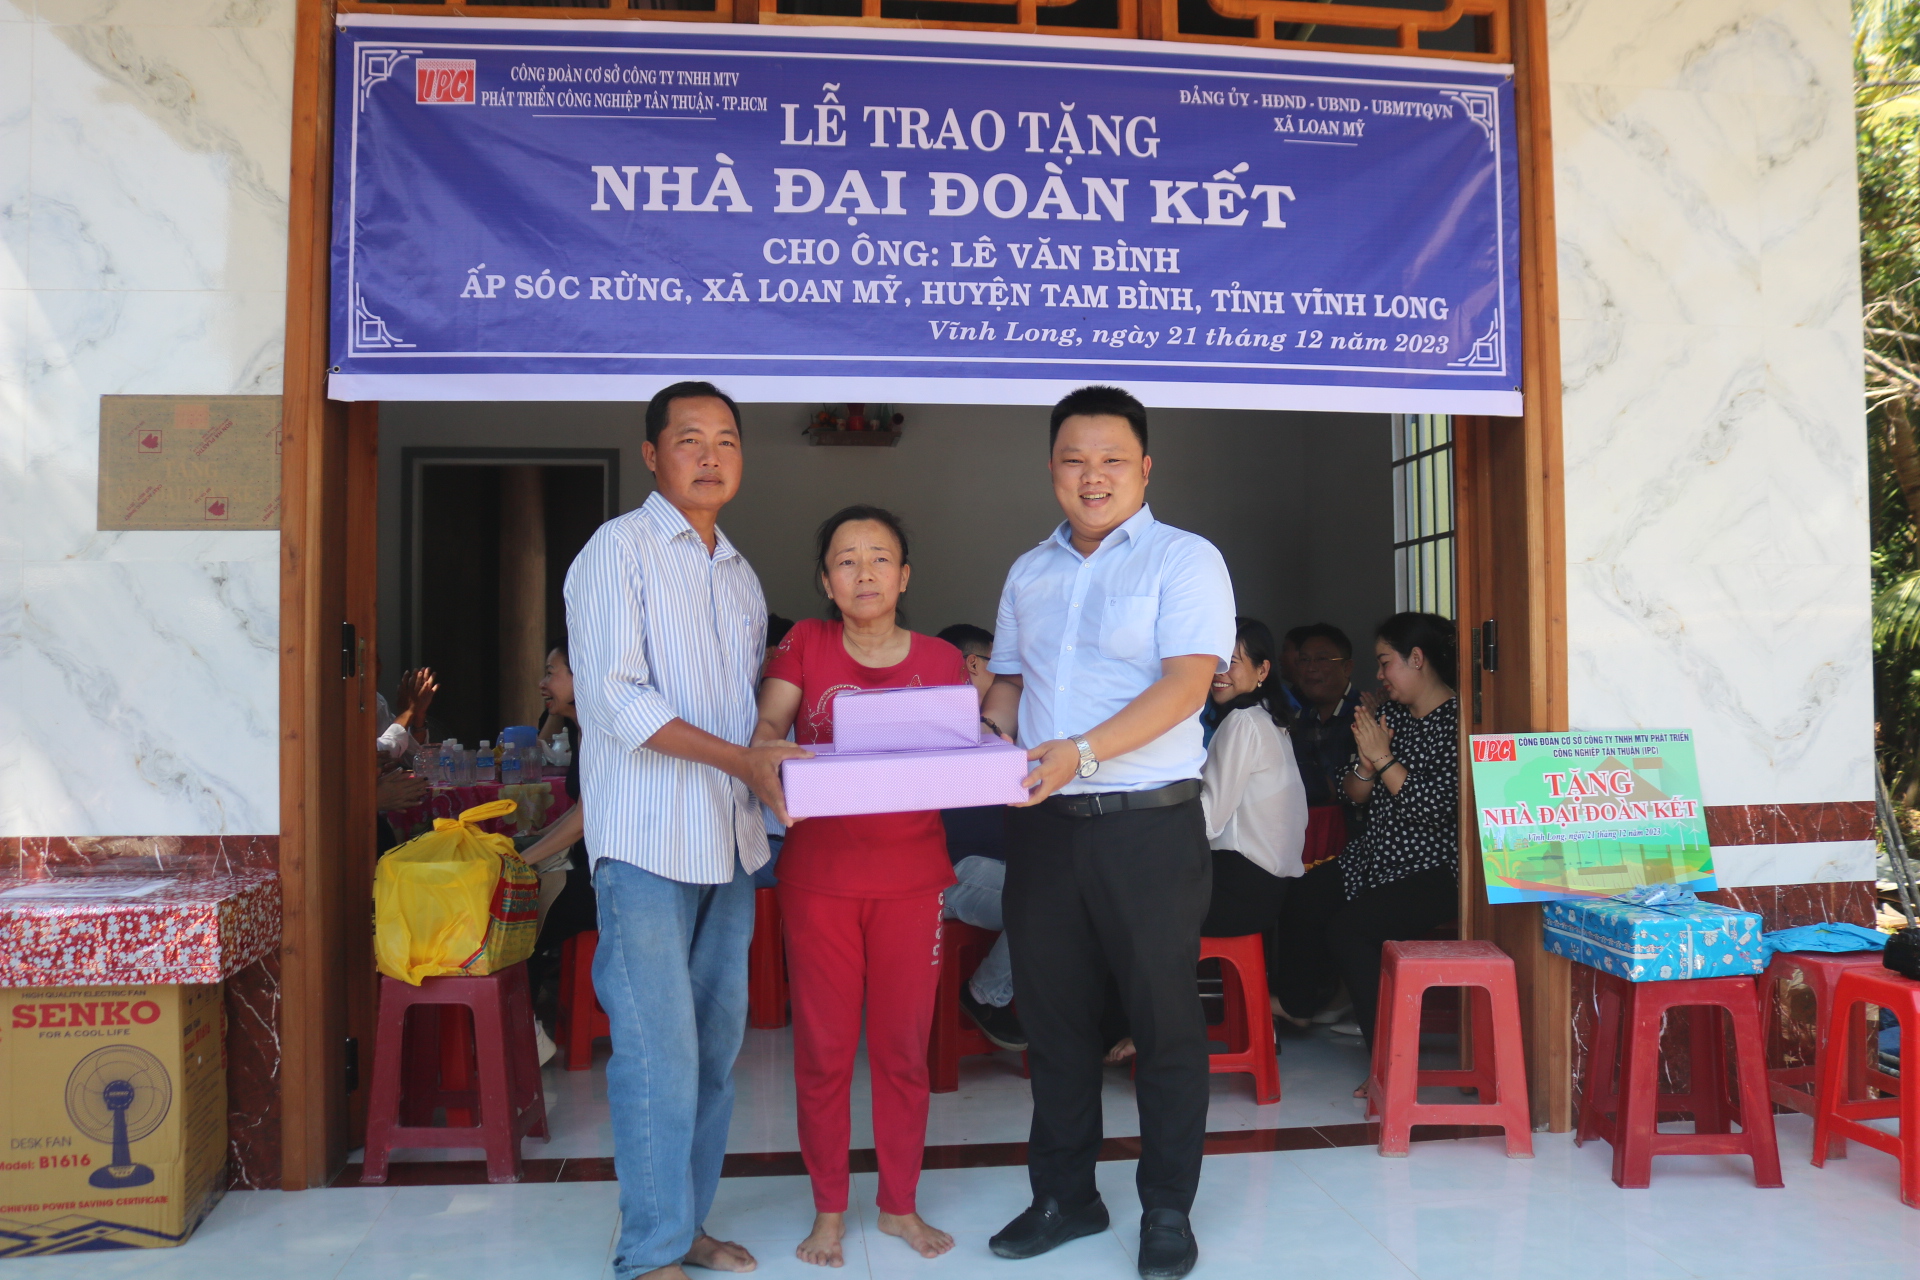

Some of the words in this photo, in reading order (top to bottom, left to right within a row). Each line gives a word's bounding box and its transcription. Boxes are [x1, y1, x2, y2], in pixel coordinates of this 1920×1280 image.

[423, 69, 467, 100] IPC
[511, 63, 544, 81] CÔNG
[548, 64, 582, 82] ĐOÀN
[585, 67, 601, 82] CƠ
[604, 64, 620, 83] SỞ
[623, 66, 656, 84] CÔNG
[659, 71, 674, 84] TY
[677, 71, 710, 85] TNHH
[714, 72, 739, 86] MTV
[481, 87, 514, 106] PHÁT
[517, 85, 554, 106] TRIỂN
[558, 89, 591, 107] CÔNG
[594, 90, 641, 111] NGHIỆP
[644, 91, 669, 108] TÂN
[671, 92, 713, 113] THUẬN
[722, 96, 767, 111] TP.HCM
[1180, 85, 1224, 104] ĐẢNG
[1228, 87, 1249, 106] ỦY
[1262, 94, 1306, 109] HĐND
[1318, 97, 1360, 112] UBND
[1372, 100, 1452, 120] UBMTTQVN
[781, 83, 846, 146] LỄ
[864, 106, 1005, 151] TRAO
[1019, 102, 1160, 167] TẶNG
[1274, 115, 1294, 132] XÃ
[1299, 119, 1339, 135] LOAN
[1343, 119, 1365, 136] MỸ
[591, 153, 752, 212] NHÀ
[774, 168, 906, 226] ĐẠI
[929, 159, 1129, 221] ĐOÀN
[1150, 162, 1296, 228] KẾT
[763, 238, 839, 265] CHO
[852, 233, 938, 266] ÔNG:
[951, 235, 997, 267] LÊ
[1007, 237, 1082, 270] VĂN
[1092, 239, 1180, 273] BÌNH
[460, 263, 505, 298] ẤP
[515, 269, 580, 299] SÓC
[590, 271, 691, 304] RỪNG,
[702, 272, 749, 301] XÃ
[759, 279, 843, 302] LOAN
[853, 274, 910, 307] MỸ,
[922, 276, 1031, 311] HUYỆN
[1040, 284, 1108, 308] TAM
[1118, 281, 1201, 314] BÌNH,
[1211, 281, 1285, 313] TỈNH
[1291, 288, 1366, 316] VĨNH
[1374, 295, 1449, 320] LONG
[929, 321, 996, 340] Vĩnh
[1004, 322, 1082, 346] Long,
[1093, 325, 1159, 348] ngày
[1167, 326, 1196, 344] 21
[1206, 327, 1287, 351] tháng
[1295, 330, 1323, 348] 12
[1331, 332, 1387, 351] năm
[1394, 334, 1449, 354] 2023
[1478, 740, 1511, 760] IPC
[1519, 736, 1538, 746] CÔNG
[1540, 736, 1559, 746] ĐOÀN
[1562, 736, 1570, 745] CƠ
[1573, 734, 1582, 744] SỞ
[1584, 735, 1603, 744] CÔNG
[1605, 736, 1613, 744] TY
[1615, 735, 1633, 743] TNHH
[1650, 733, 1668, 742] PHÁT
[1670, 731, 1689, 741] TRIỂN
[1554, 748, 1572, 757] CÔNG
[1575, 748, 1600, 758] NGHIỆP
[1602, 746, 1616, 756] TÂN
[1617, 747, 1640, 756] THUẬN
[1643, 747, 1658, 755] (IPC)
[1543, 767, 1634, 803] TẶNG
[1482, 801, 1535, 828] NHÀ
[1538, 804, 1580, 828] ĐẠI
[1584, 797, 1649, 822] ĐOÀN
[1650, 795, 1698, 819] KẾT
[1528, 832, 1546, 841] Vĩnh
[1547, 833, 1568, 841] Long,
[1569, 831, 1586, 841] ngày
[1597, 829, 1617, 840] tháng
[1628, 828, 1644, 837] năm
[1645, 828, 1661, 836] 2023
[45, 991, 82, 999] QUALITY
[84, 990, 125, 998] ELECTRIC
[12, 1000, 161, 1028] SENKO
[39, 1031, 60, 1039] FOR
[74, 1029, 105, 1037] COOL
[107, 1028, 131, 1036] LIFE
[10, 1137, 42, 1150] DESK
[45, 1136, 72, 1148] FAN
[39, 1154, 92, 1169] B1616
[0, 1204, 40, 1213] CHIEVED
[42, 1201, 76, 1211] POWER
[78, 1199, 114, 1209] SAVING
